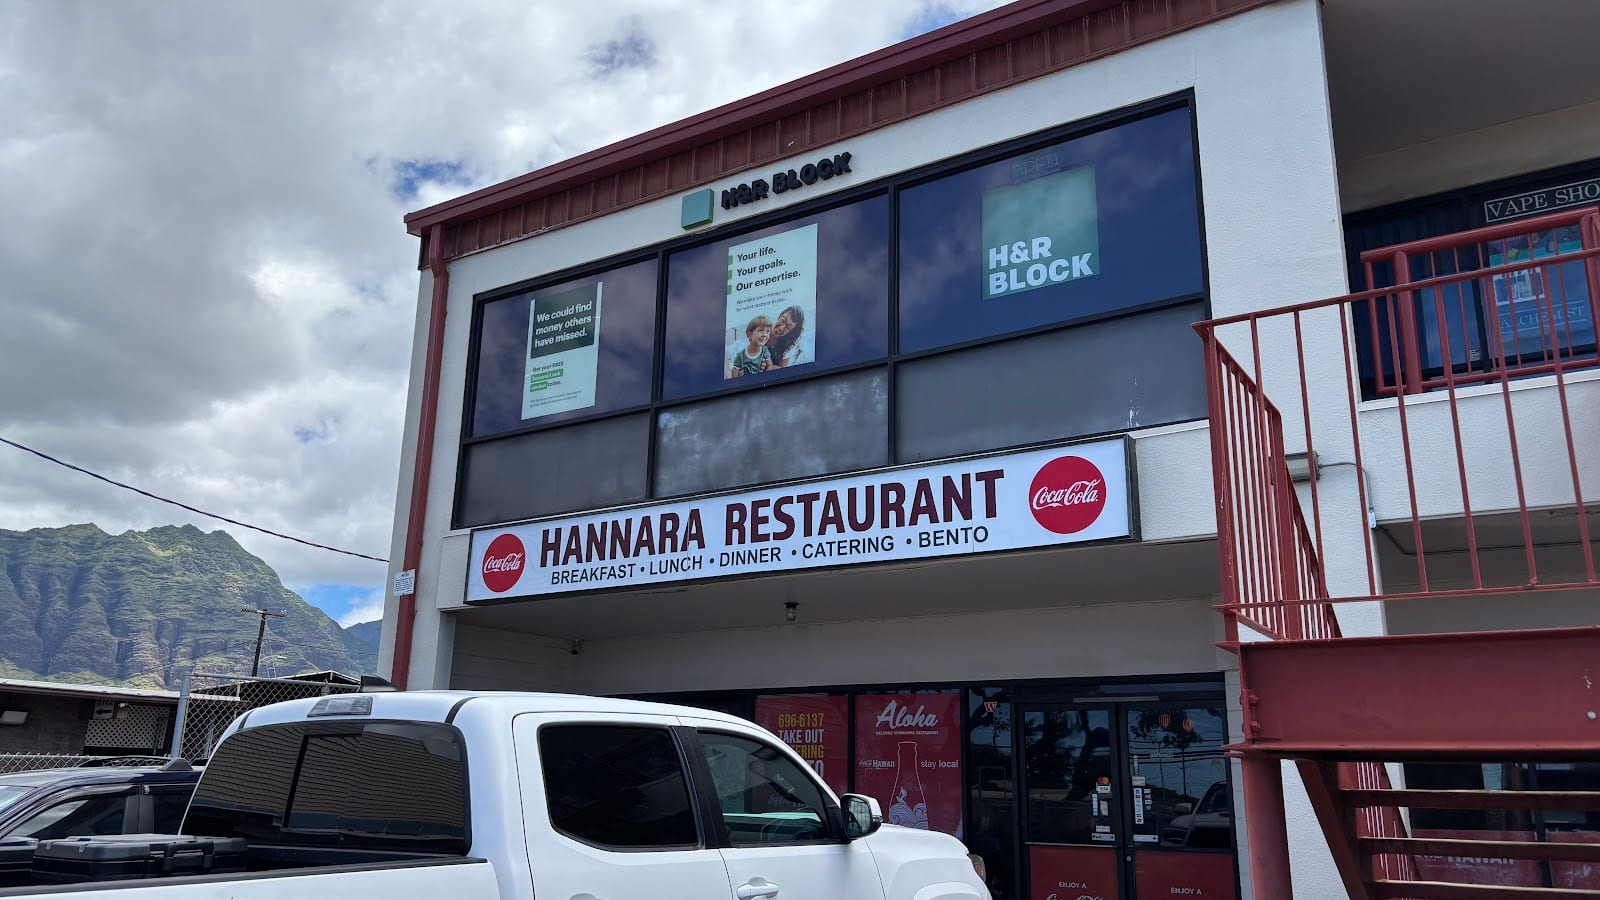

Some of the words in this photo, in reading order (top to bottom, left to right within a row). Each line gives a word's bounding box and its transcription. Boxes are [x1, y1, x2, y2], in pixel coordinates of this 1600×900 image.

[772, 151, 852, 195] BLOCK
[1487, 193, 1548, 217] VAPE
[737, 252, 757, 262] Your
[759, 246, 776, 257] life.
[989, 236, 1052, 269] H&R
[737, 266, 757, 277] Your
[758, 258, 786, 273] goals.
[989, 252, 1094, 295] BLOCK
[736, 281, 753, 292] Our
[754, 270, 801, 286] expertise.
[536, 313, 551, 323] We
[551, 305, 574, 319] could
[575, 300, 592, 312] find
[535, 323, 562, 336] money
[564, 315, 592, 328] others
[534, 338, 554, 348] have
[555, 327, 588, 342] missed.
[1032, 478, 1101, 510] Coca-Cola
[540, 508, 706, 568] HANNARA
[725, 469, 1004, 546] RESTAURANT
[483, 552, 521, 574] Coca-Cola
[551, 563, 636, 585] BREAKFAST
[649, 555, 703, 576] LUNCH
[719, 547, 781, 567] DINNER
[802, 535, 894, 559] CATERING
[919, 525, 989, 548] BENTO
[778, 713, 824, 728] 696-6137
[876, 699, 939, 730] Aloha
[778, 730, 802, 743] TAKE
[805, 729, 824, 743] OUT
[920, 759, 937, 770] stay
[938, 759, 959, 768] local
[1059, 881, 1080, 889] ENJOY
[1170, 887, 1195, 895] ENJOY
